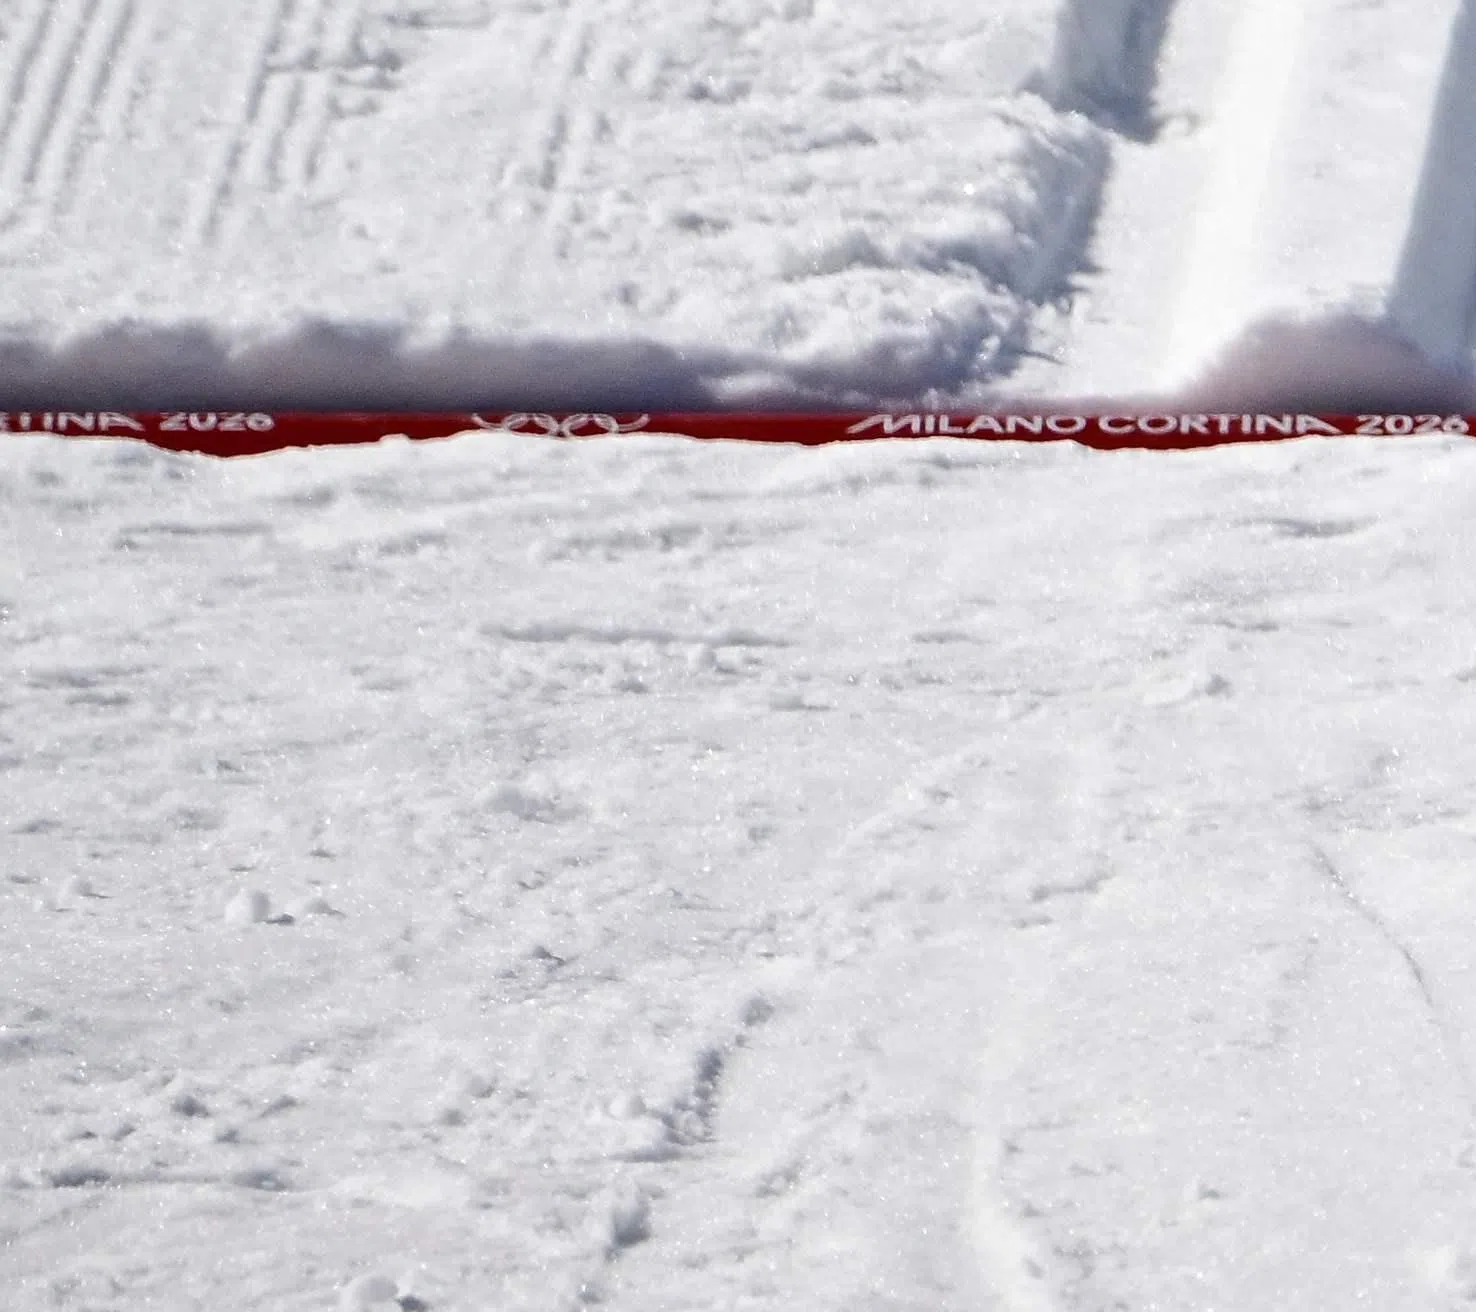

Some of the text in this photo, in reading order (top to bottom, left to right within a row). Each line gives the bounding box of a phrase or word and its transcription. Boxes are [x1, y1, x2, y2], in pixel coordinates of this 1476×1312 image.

[0, 411, 275, 432] TINA 2026
[846, 413, 1470, 435] MILANO CORTINA 2026
